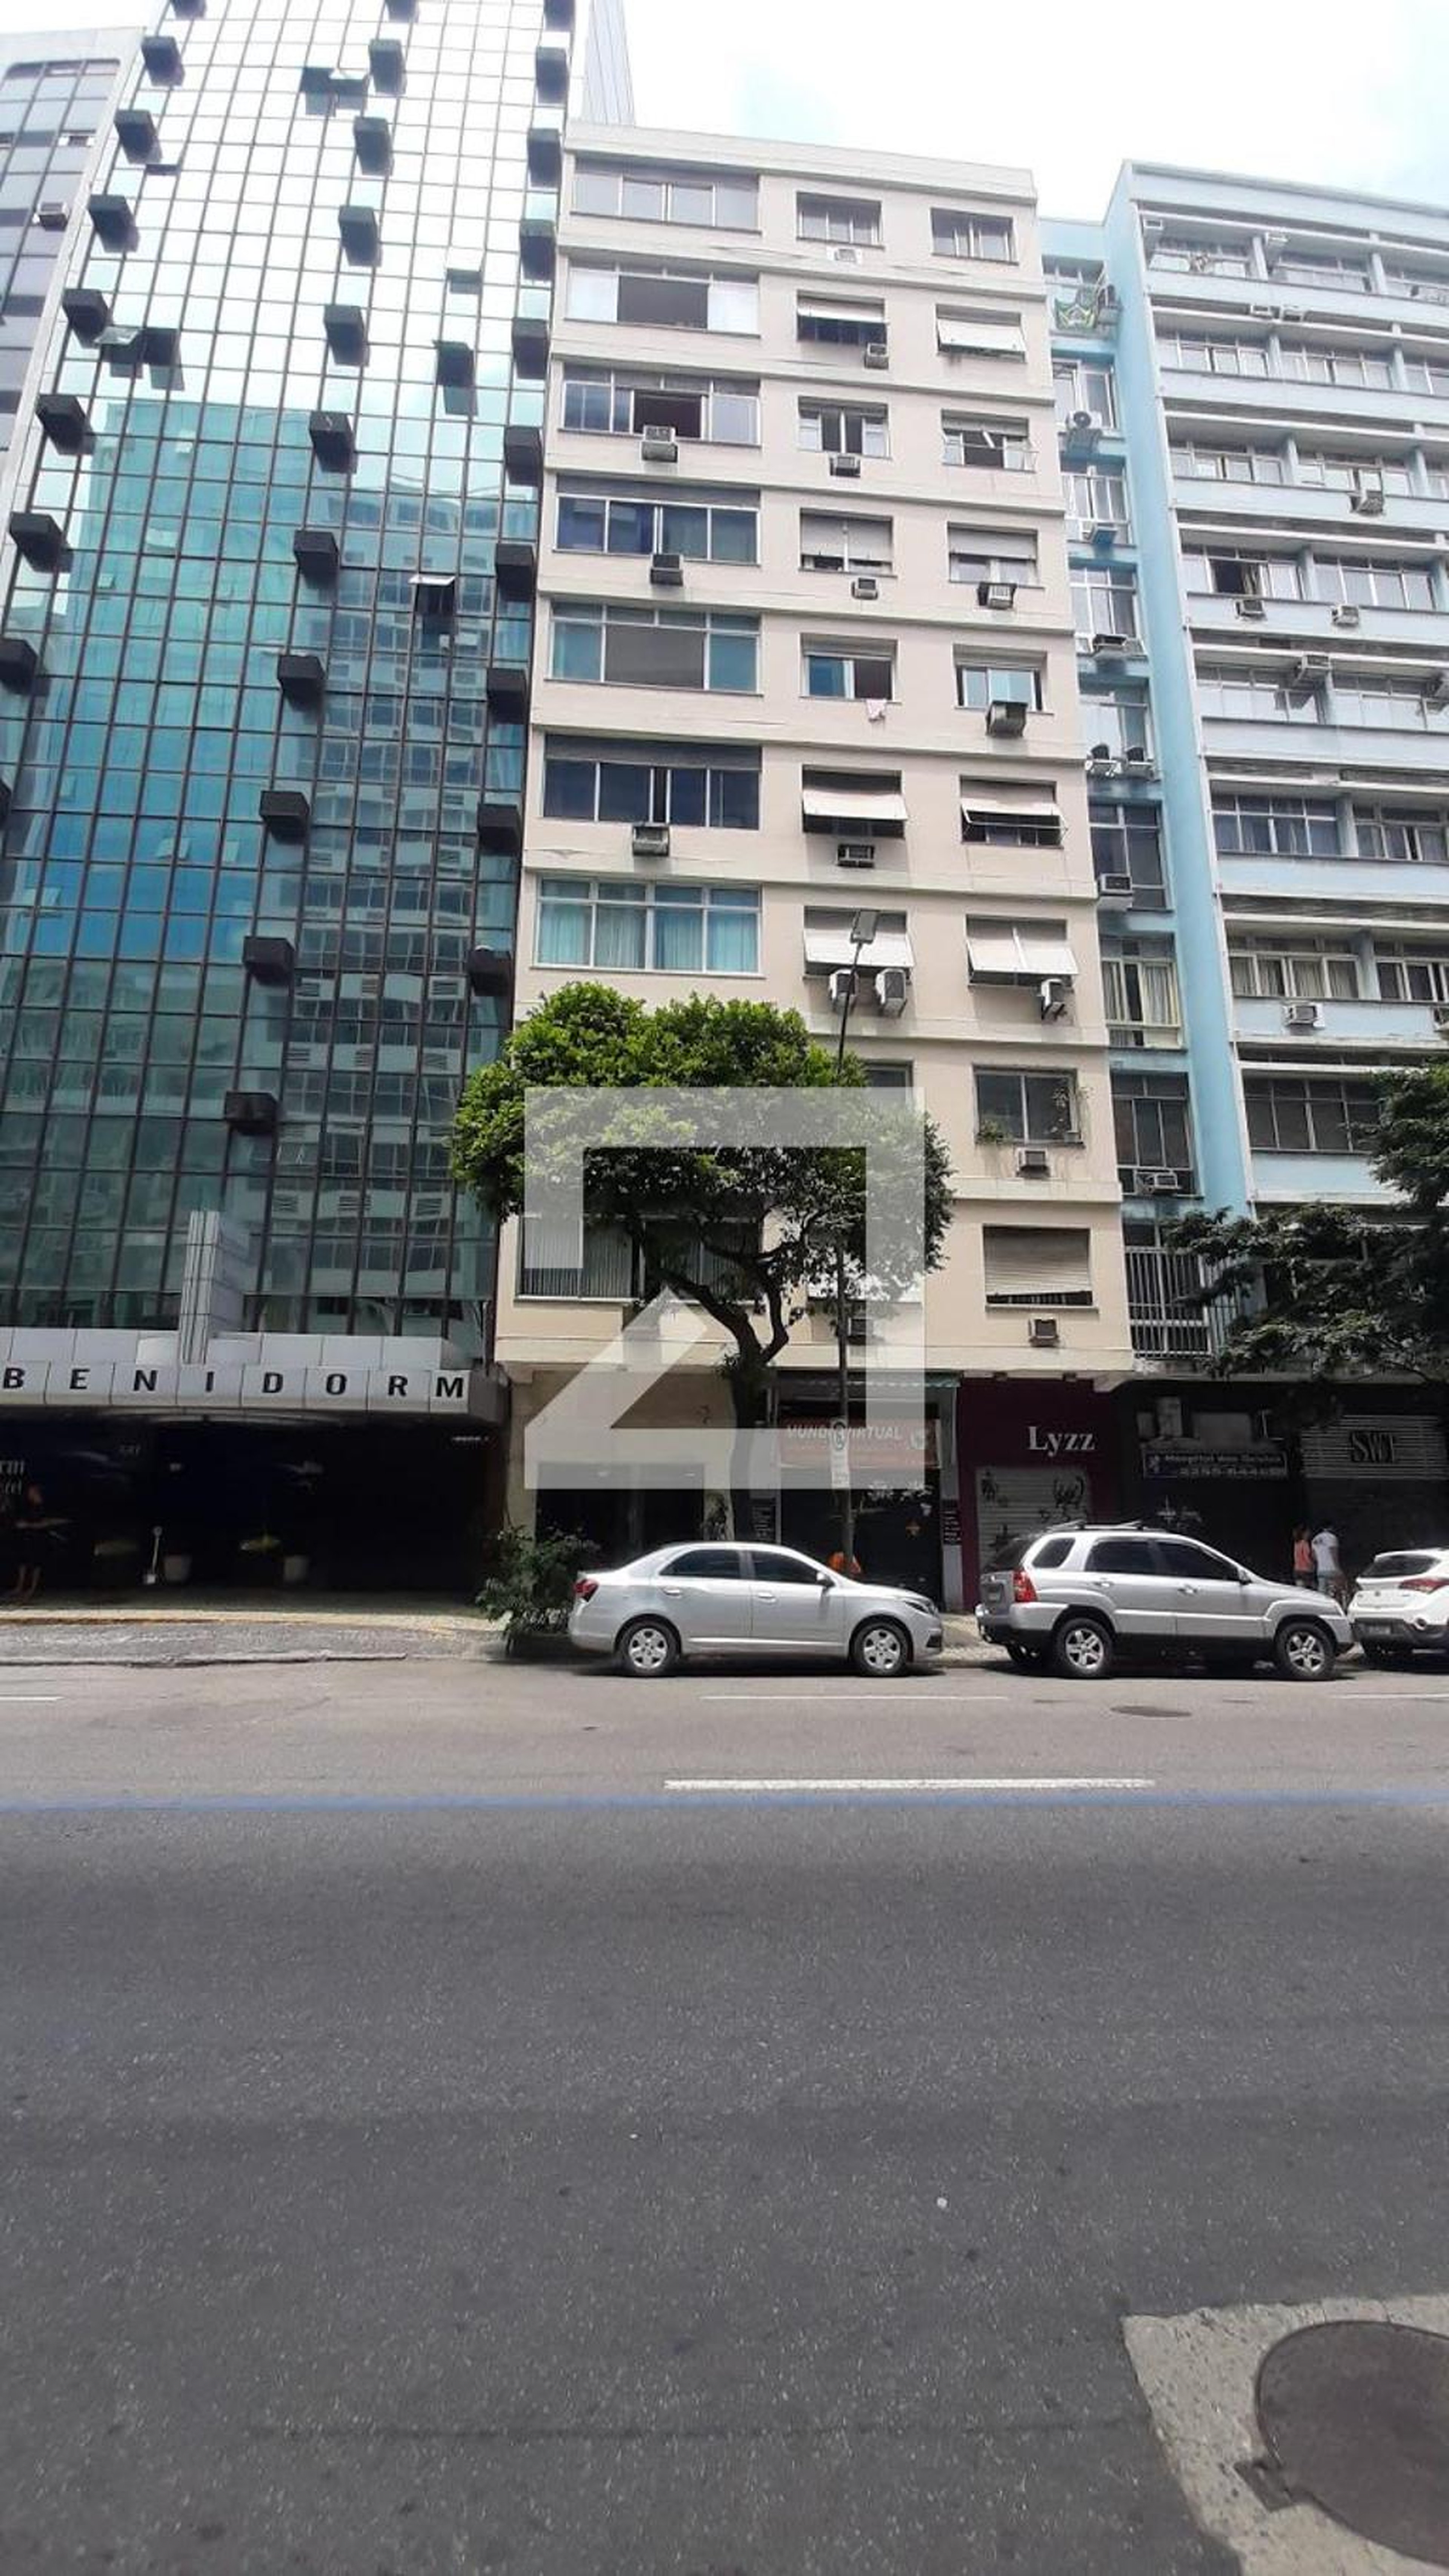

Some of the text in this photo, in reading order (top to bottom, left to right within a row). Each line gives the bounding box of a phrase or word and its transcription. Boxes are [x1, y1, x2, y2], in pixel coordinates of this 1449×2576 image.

[2, 1367, 464, 1398] BENIDORM
[788, 1425, 832, 1438] MUND
[1027, 1426, 1096, 1456] Lyzz
